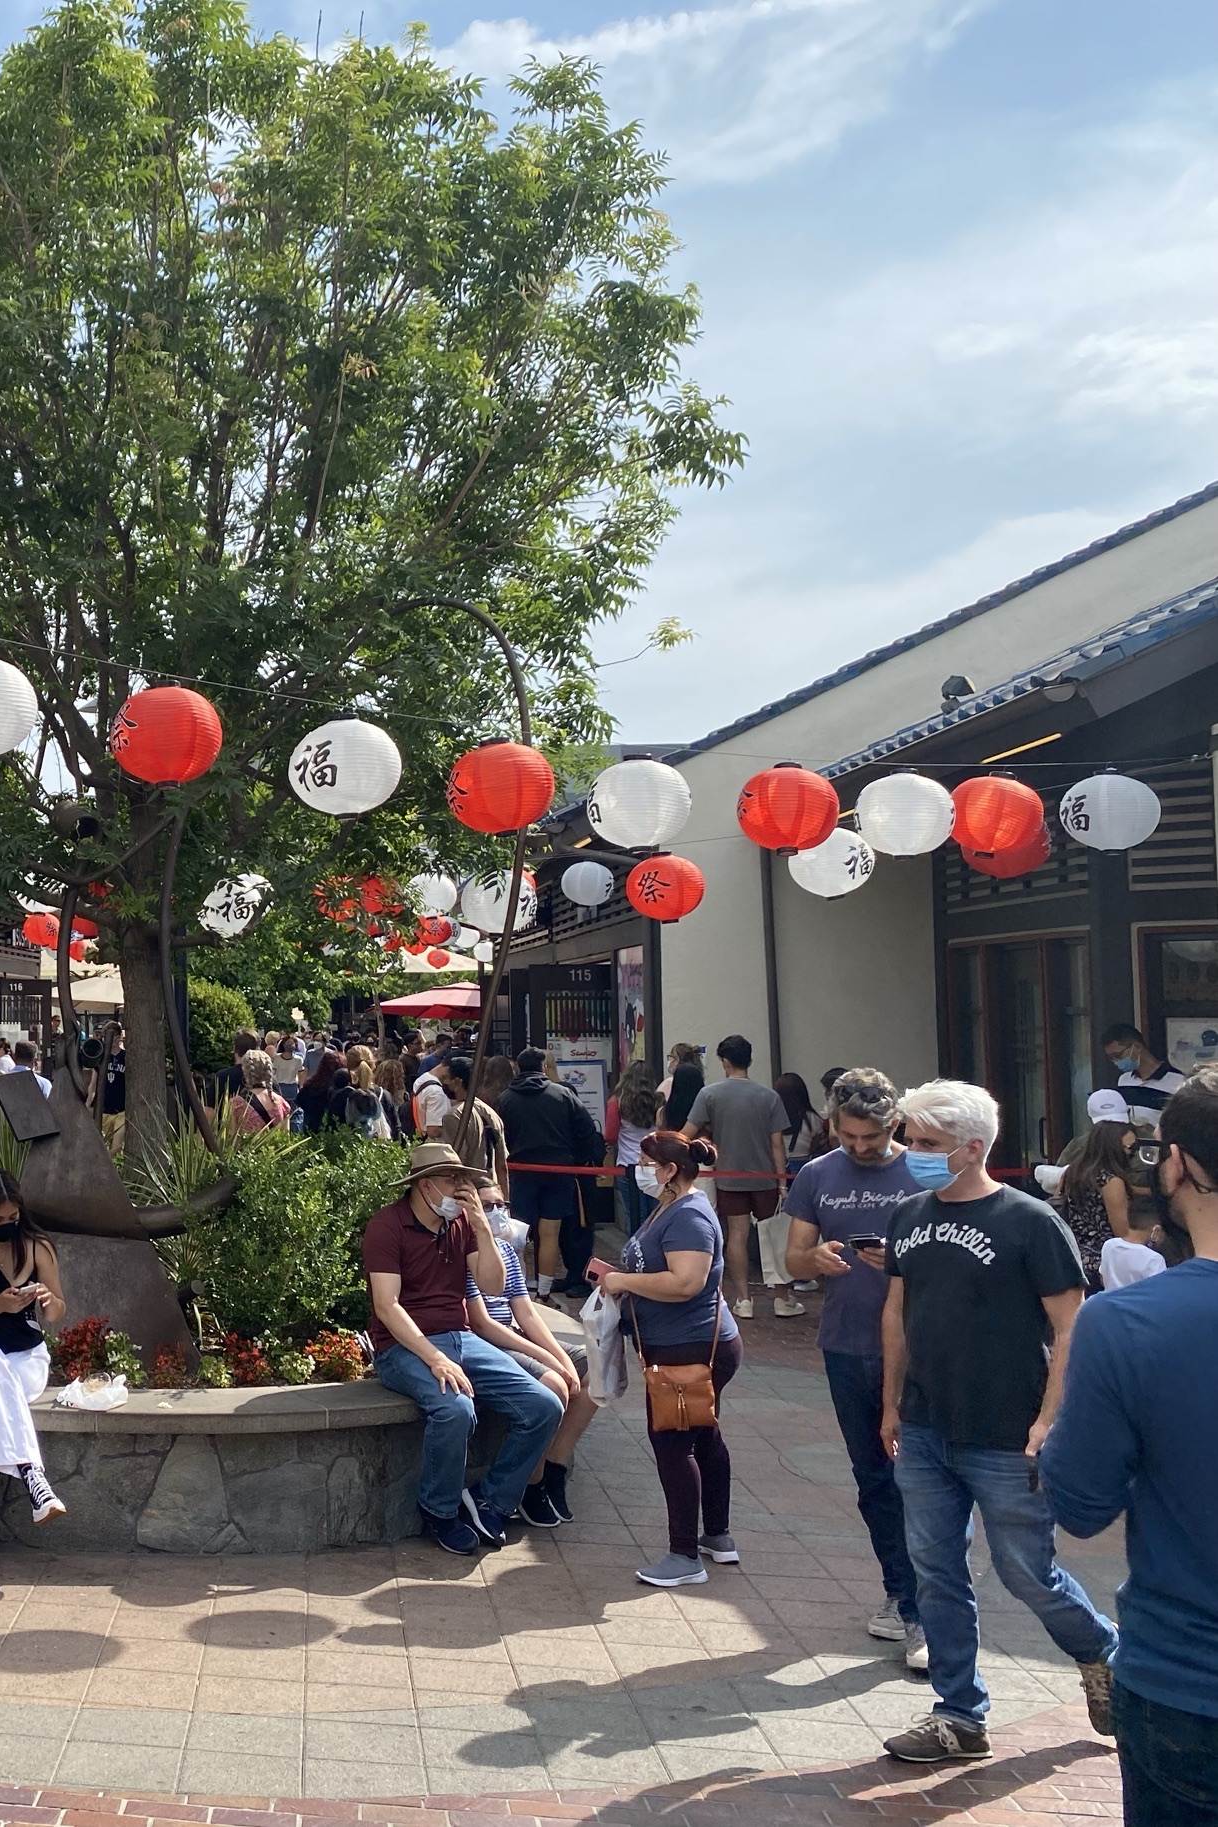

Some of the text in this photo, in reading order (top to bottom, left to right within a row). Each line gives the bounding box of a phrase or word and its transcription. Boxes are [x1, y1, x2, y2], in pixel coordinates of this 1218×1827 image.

[294, 739, 338, 792] 福
[1060, 794, 1090, 832] 福
[842, 842, 874, 881] 福
[637, 870, 672, 905] 祭
[216, 891, 251, 923] 福
[9, 983, 23, 992] 116
[569, 969, 592, 982] 115
[894, 1222, 996, 1265] Cold Chillin
